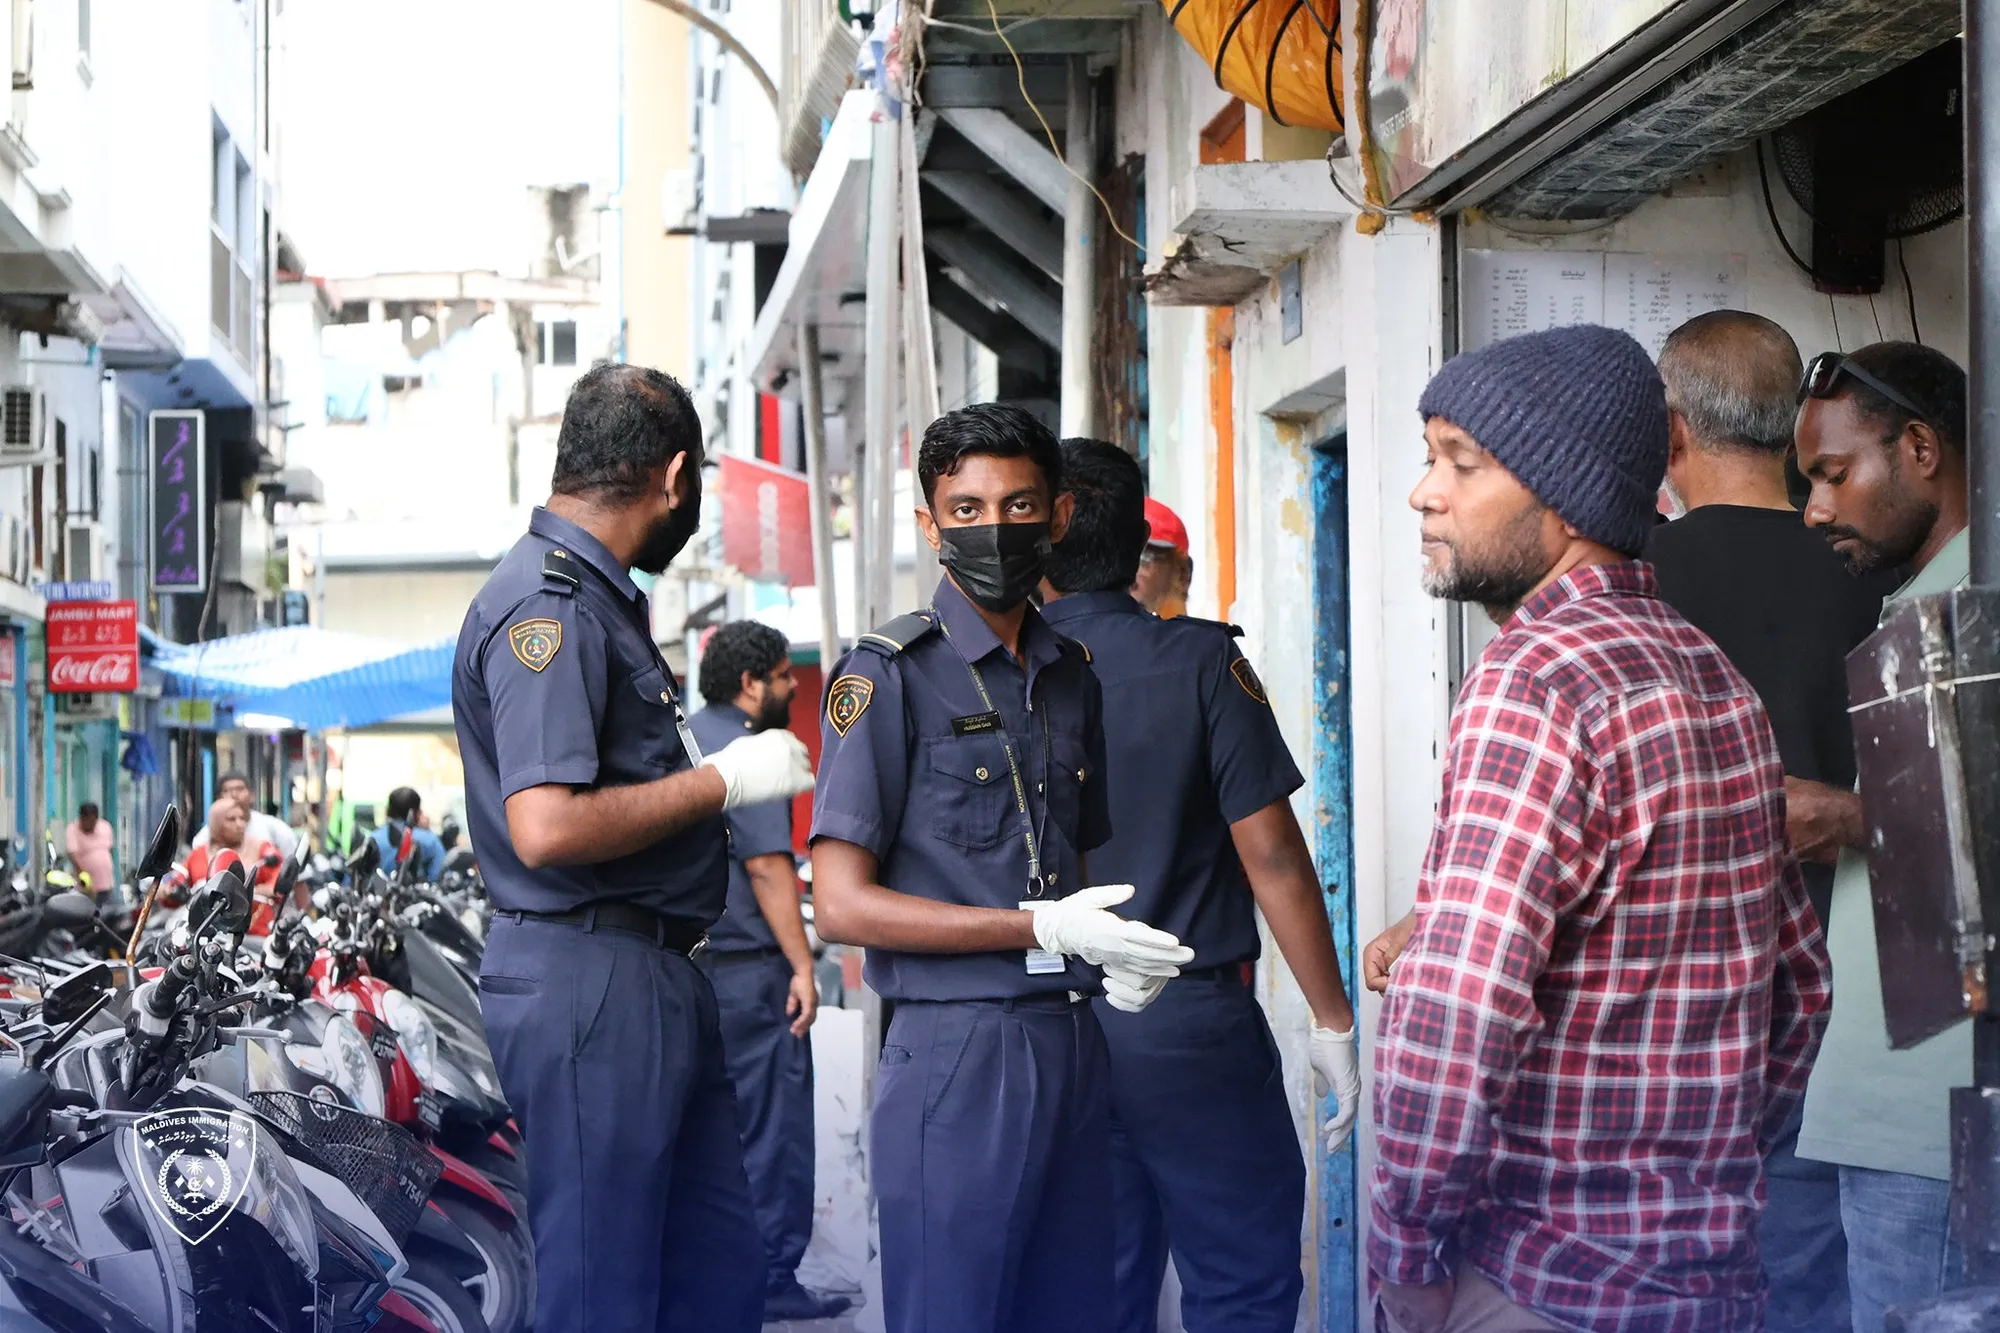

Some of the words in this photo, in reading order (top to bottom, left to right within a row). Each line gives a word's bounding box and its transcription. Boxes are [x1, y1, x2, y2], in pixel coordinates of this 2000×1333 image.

[96, 606, 133, 619] MART
[1005, 745, 1017, 774] MALDIVES
[1013, 774, 1025, 813] IMMIGRATION
[1025, 833, 1035, 859] MALDIVE
